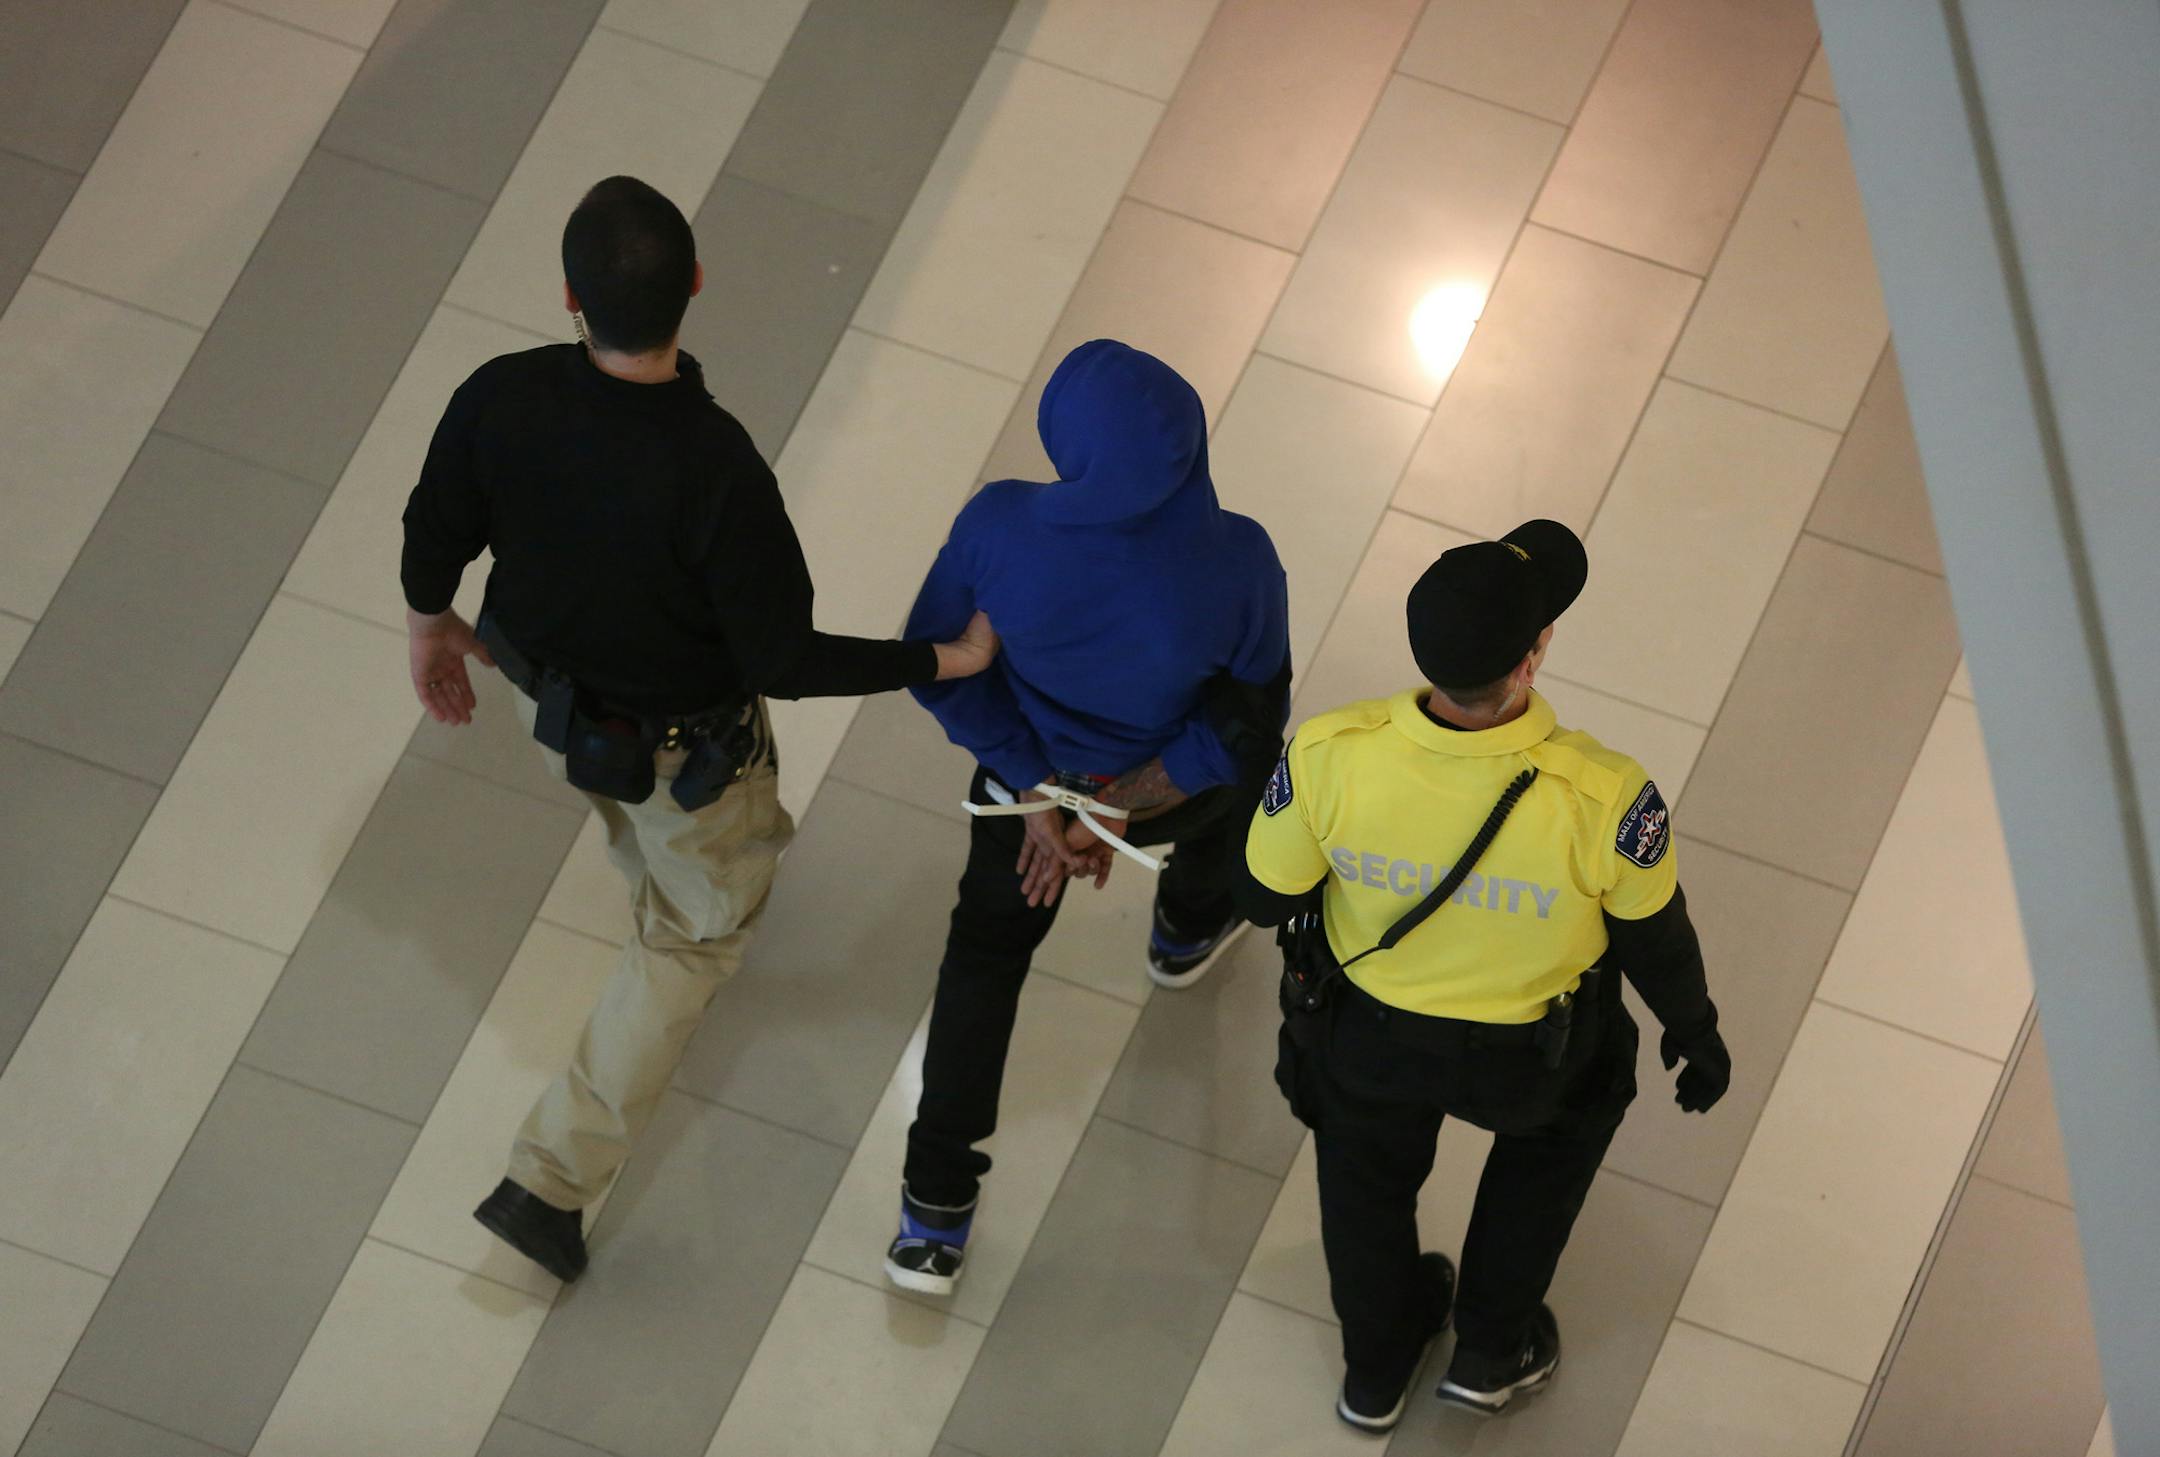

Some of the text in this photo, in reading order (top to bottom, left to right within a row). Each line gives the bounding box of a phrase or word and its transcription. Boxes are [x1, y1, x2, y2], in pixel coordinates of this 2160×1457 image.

[1617, 786, 1655, 842] MALL OF AMERIC
[1330, 847, 1560, 919] SECURITY
